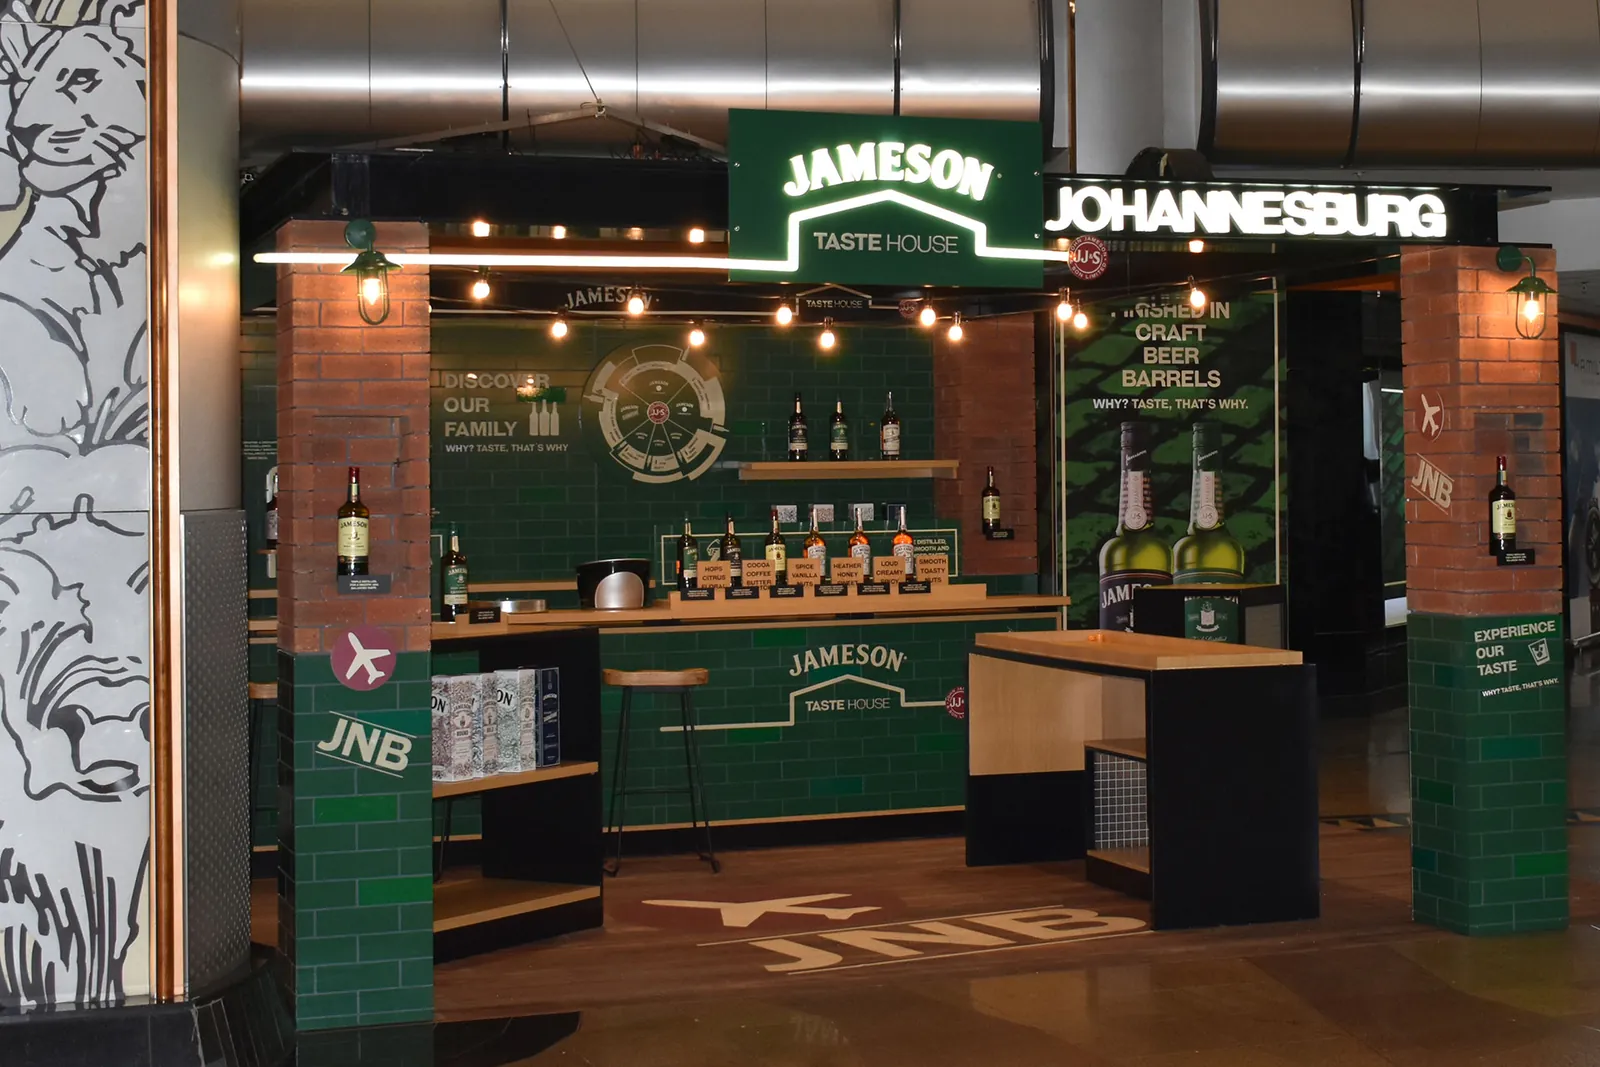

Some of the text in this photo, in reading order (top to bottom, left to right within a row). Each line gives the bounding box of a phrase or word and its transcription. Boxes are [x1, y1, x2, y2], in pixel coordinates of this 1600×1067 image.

[784, 142, 994, 201] JAMESON
[1045, 186, 1447, 238] JOHANNESBURG
[813, 232, 958, 253] TASTE HOUSE
[1073, 249, 1101, 264] JJ&S
[564, 287, 652, 309] JAMESN
[806, 300, 863, 308] TASTE HOUSE
[1210, 302, 1230, 319] IN
[1135, 323, 1206, 341] CRAFT
[1143, 347, 1200, 364] BEER
[1122, 370, 1221, 388] BARRELS
[443, 397, 490, 412] OUR
[1093, 398, 1249, 410] WHY? TASTE, THAT'S WHY.
[445, 421, 518, 437] FAMILY
[446, 444, 474, 452] WHY?
[511, 442, 544, 452] THAT'S
[545, 443, 569, 451] WHY
[1411, 459, 1453, 508] JNB
[1474, 620, 1556, 642] EXPERIENCE
[789, 644, 904, 677] JAMESON
[1476, 645, 1505, 659] OUR
[1477, 660, 1517, 676] TASTE
[1482, 688, 1500, 697] WHY?
[1501, 685, 1521, 694] TASTE,
[1521, 680, 1543, 689] THAT'S
[805, 698, 891, 712] TASTE HOUSE
[317, 718, 412, 771] JNB
[748, 908, 1147, 972] JNB
